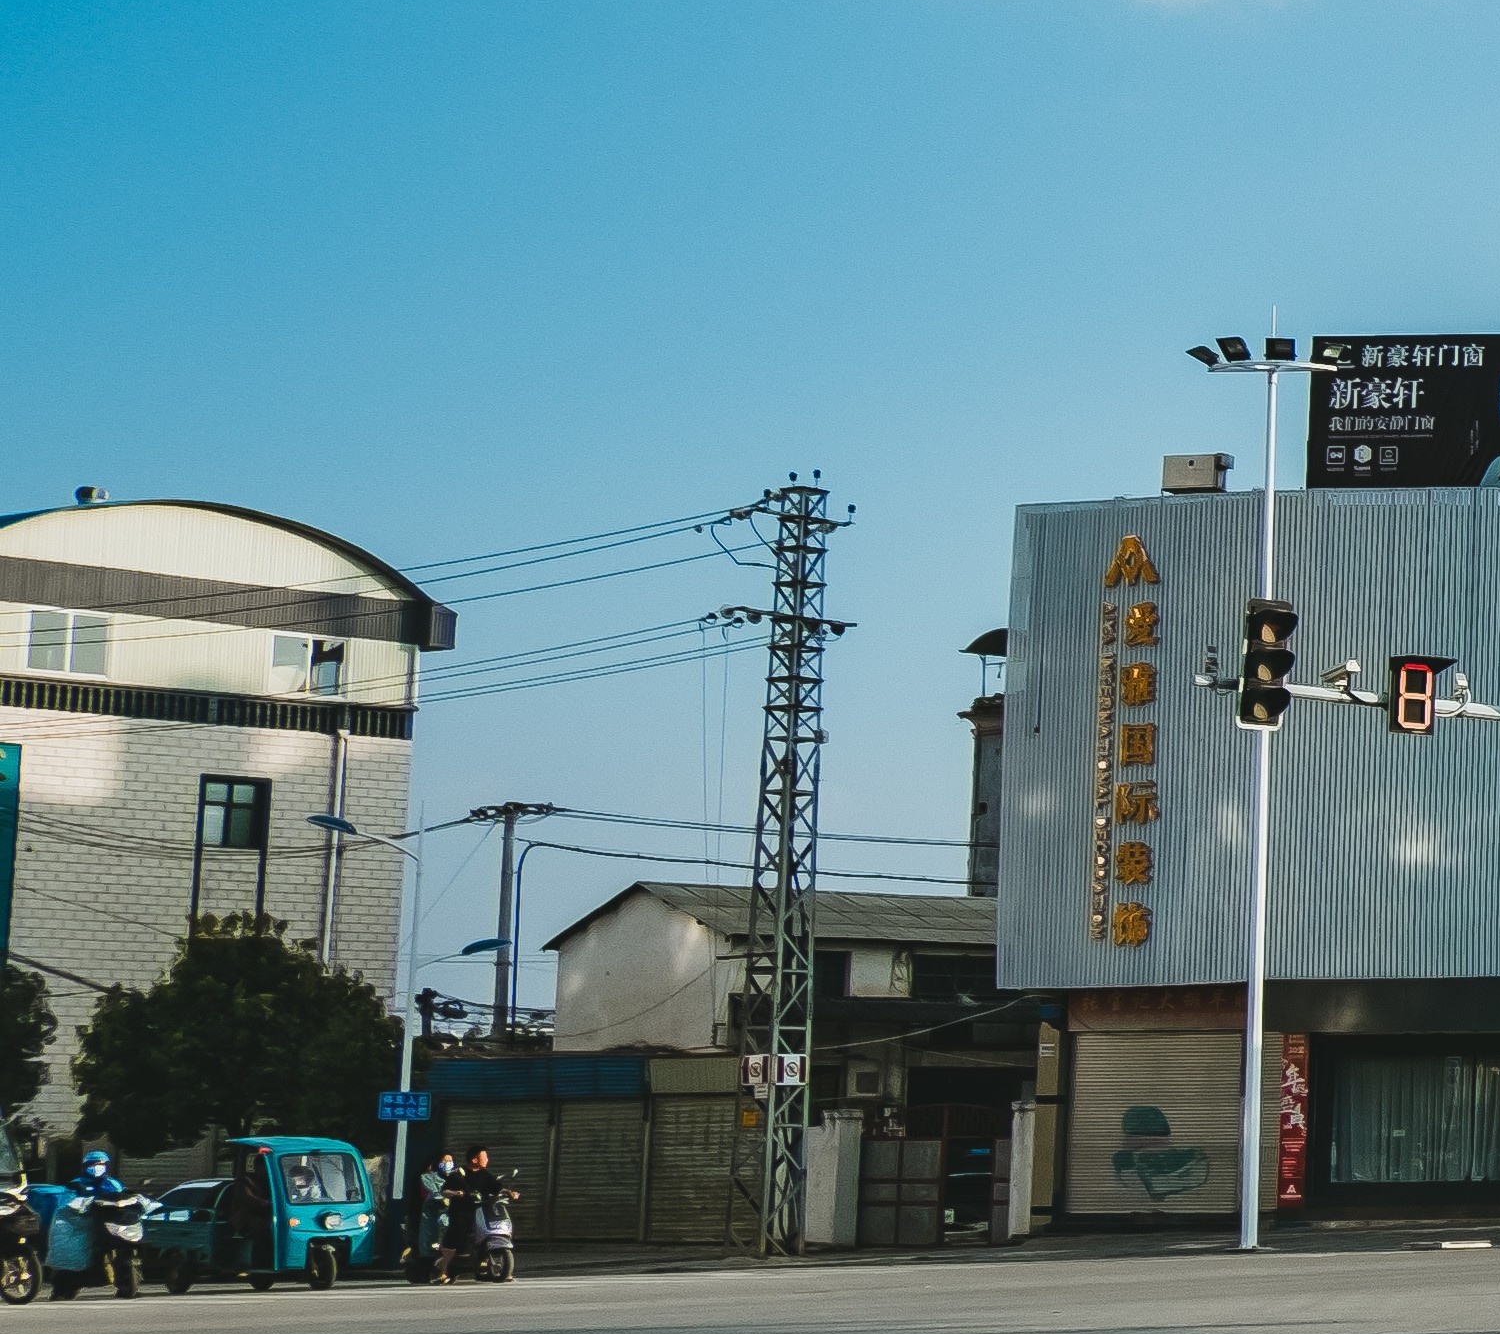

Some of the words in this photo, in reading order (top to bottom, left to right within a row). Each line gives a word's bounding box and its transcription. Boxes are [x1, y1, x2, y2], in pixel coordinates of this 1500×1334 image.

[1361, 344, 1485, 367] 新豪轩门窗
[1329, 377, 1424, 409] 新豪轩
[1114, 602, 1160, 946] 爱雅国际装饰
